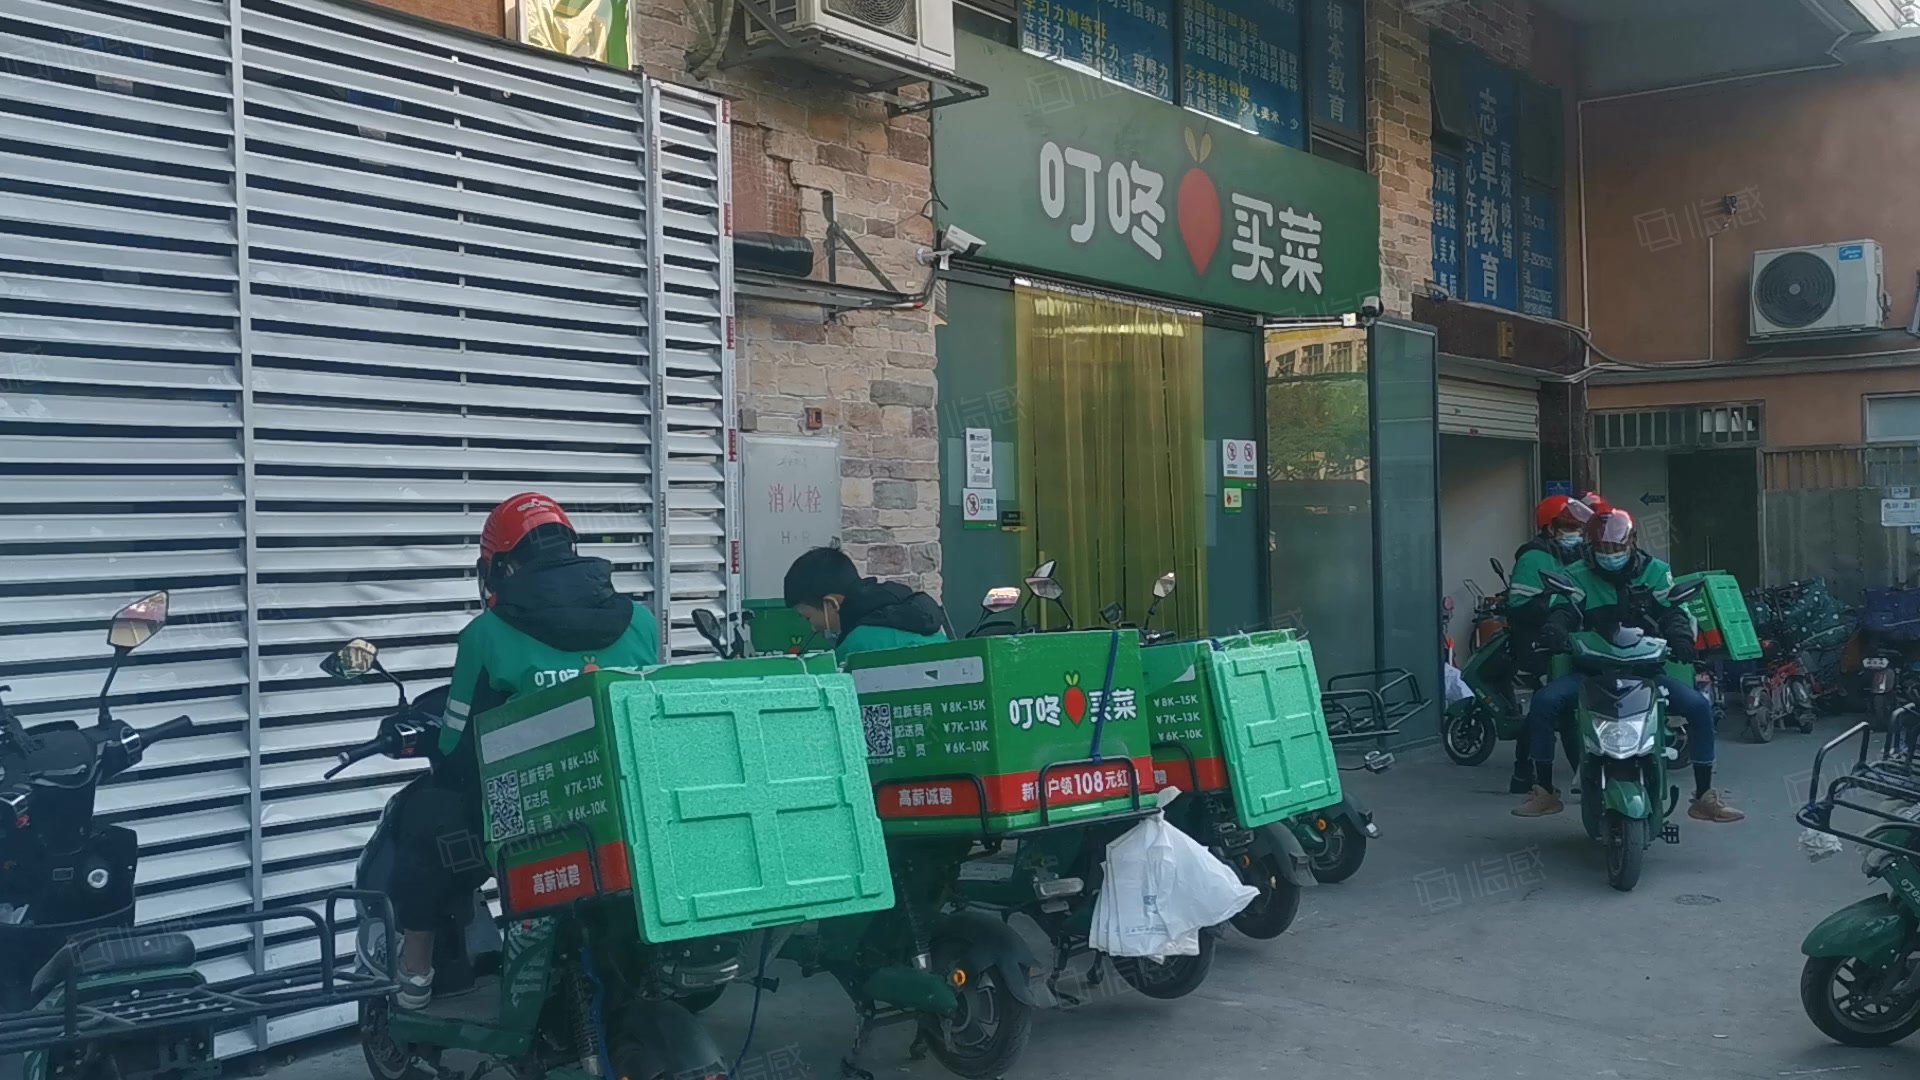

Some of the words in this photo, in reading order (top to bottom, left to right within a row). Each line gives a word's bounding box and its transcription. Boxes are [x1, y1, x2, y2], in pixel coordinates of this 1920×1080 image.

[1479, 87, 1499, 300] 志卓教育
[1039, 140, 1167, 261] 叮咚
[1230, 192, 1325, 296] 买菜
[768, 483, 822, 514] 消火栓
[1008, 694, 1061, 730] 叮咚
[898, 787, 953, 808] 高薪诚聘
[1021, 769, 1141, 802] 新户领108元红
